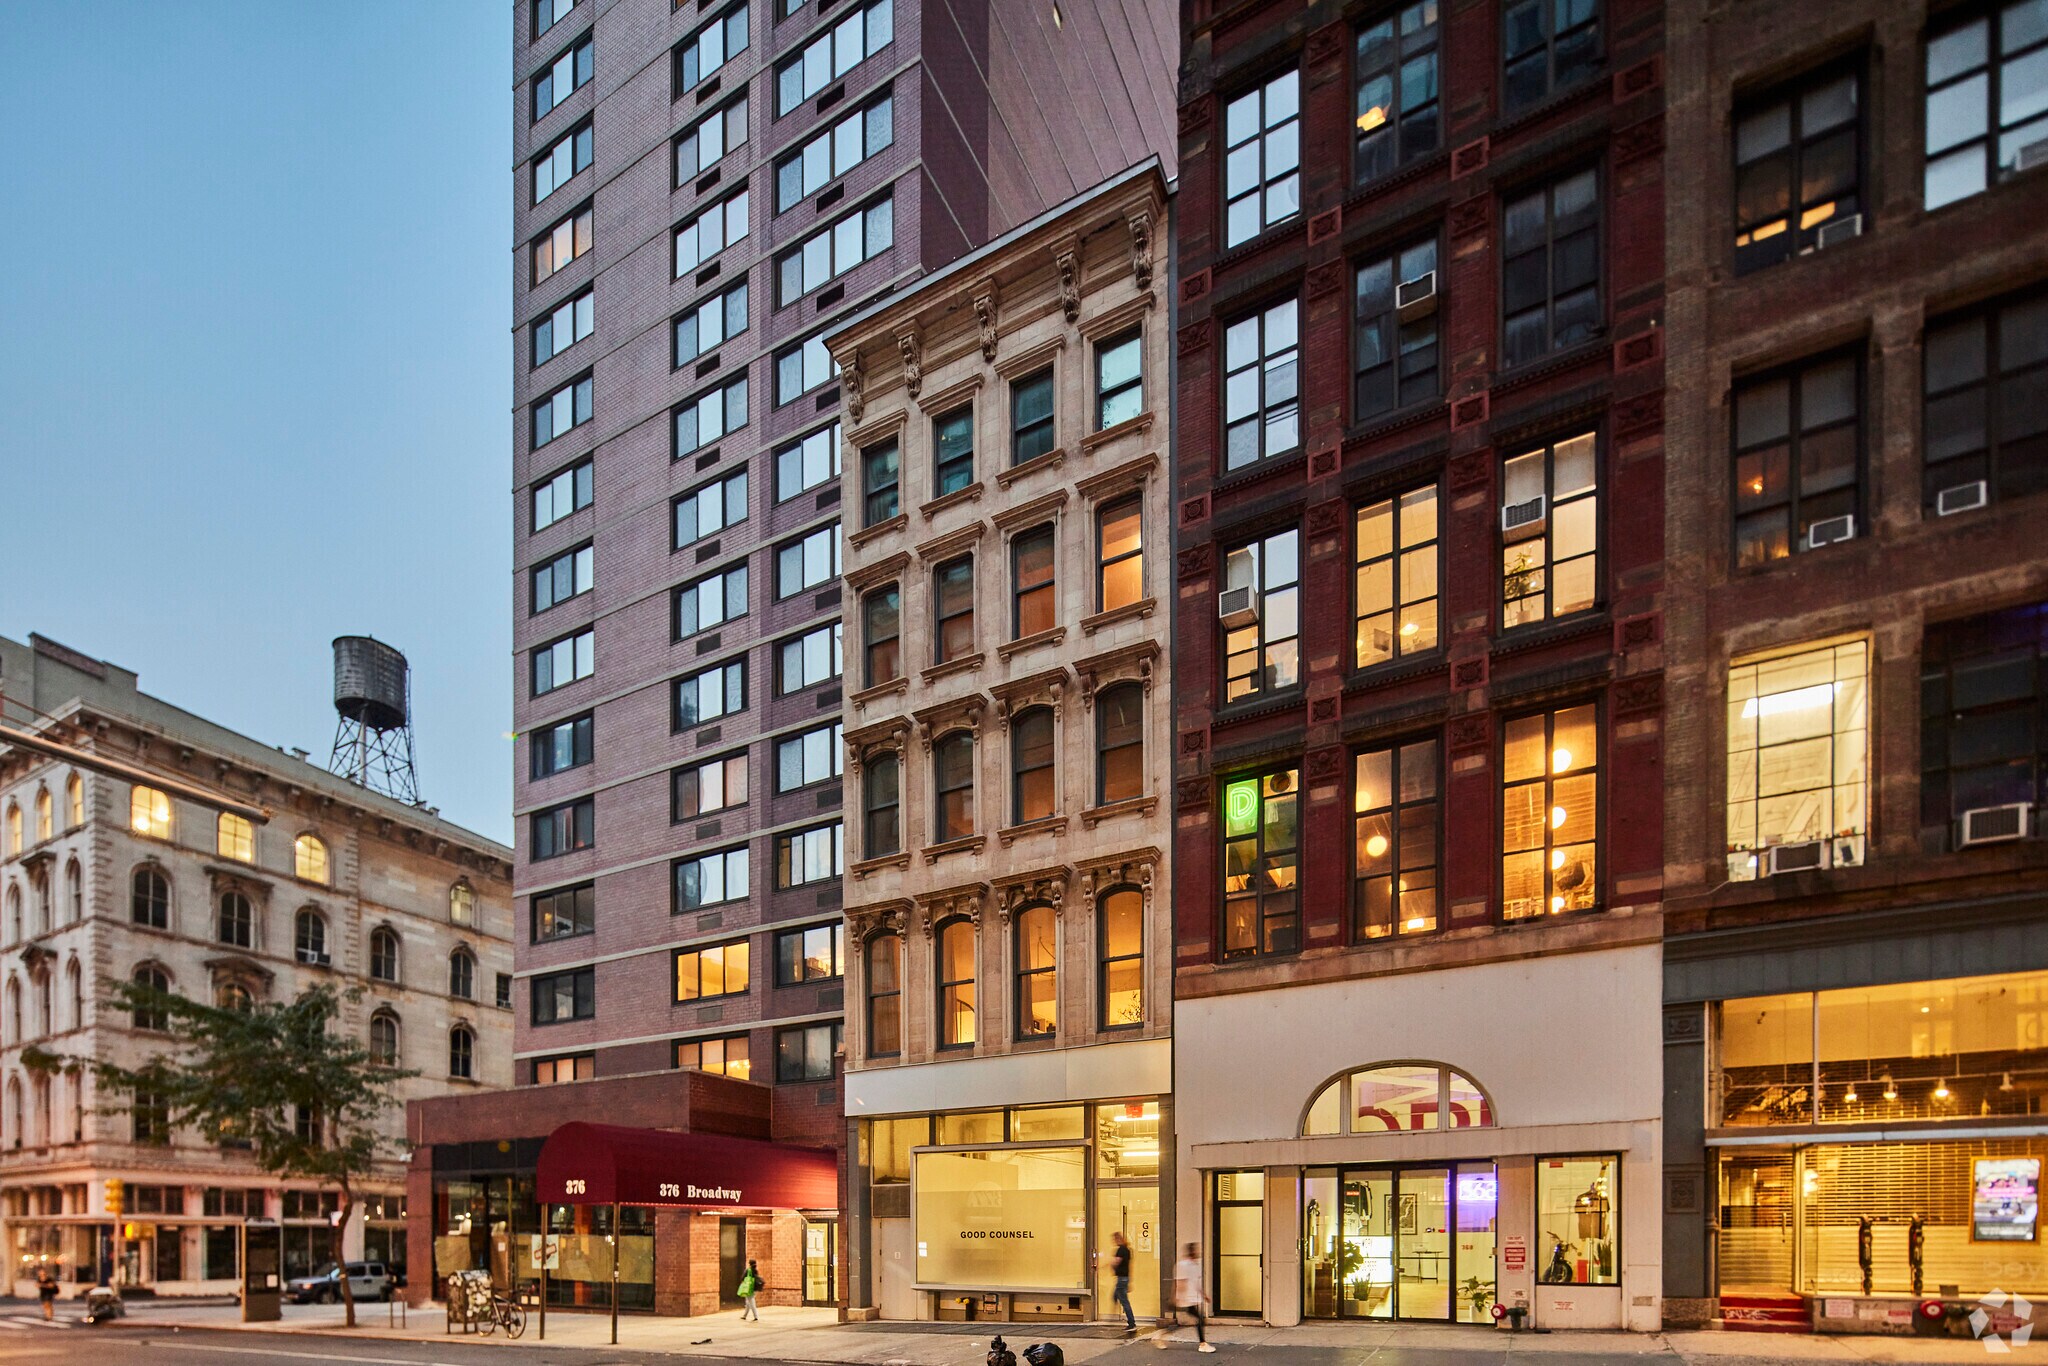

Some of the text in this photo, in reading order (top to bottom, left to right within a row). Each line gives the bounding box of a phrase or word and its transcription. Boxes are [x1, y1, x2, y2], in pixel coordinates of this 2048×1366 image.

[1230, 786, 1256, 820] D
[565, 1179, 586, 1195] 376
[659, 1183, 742, 1203] 376 Broadway
[960, 1230, 1035, 1239] GOOD COUNSEL
